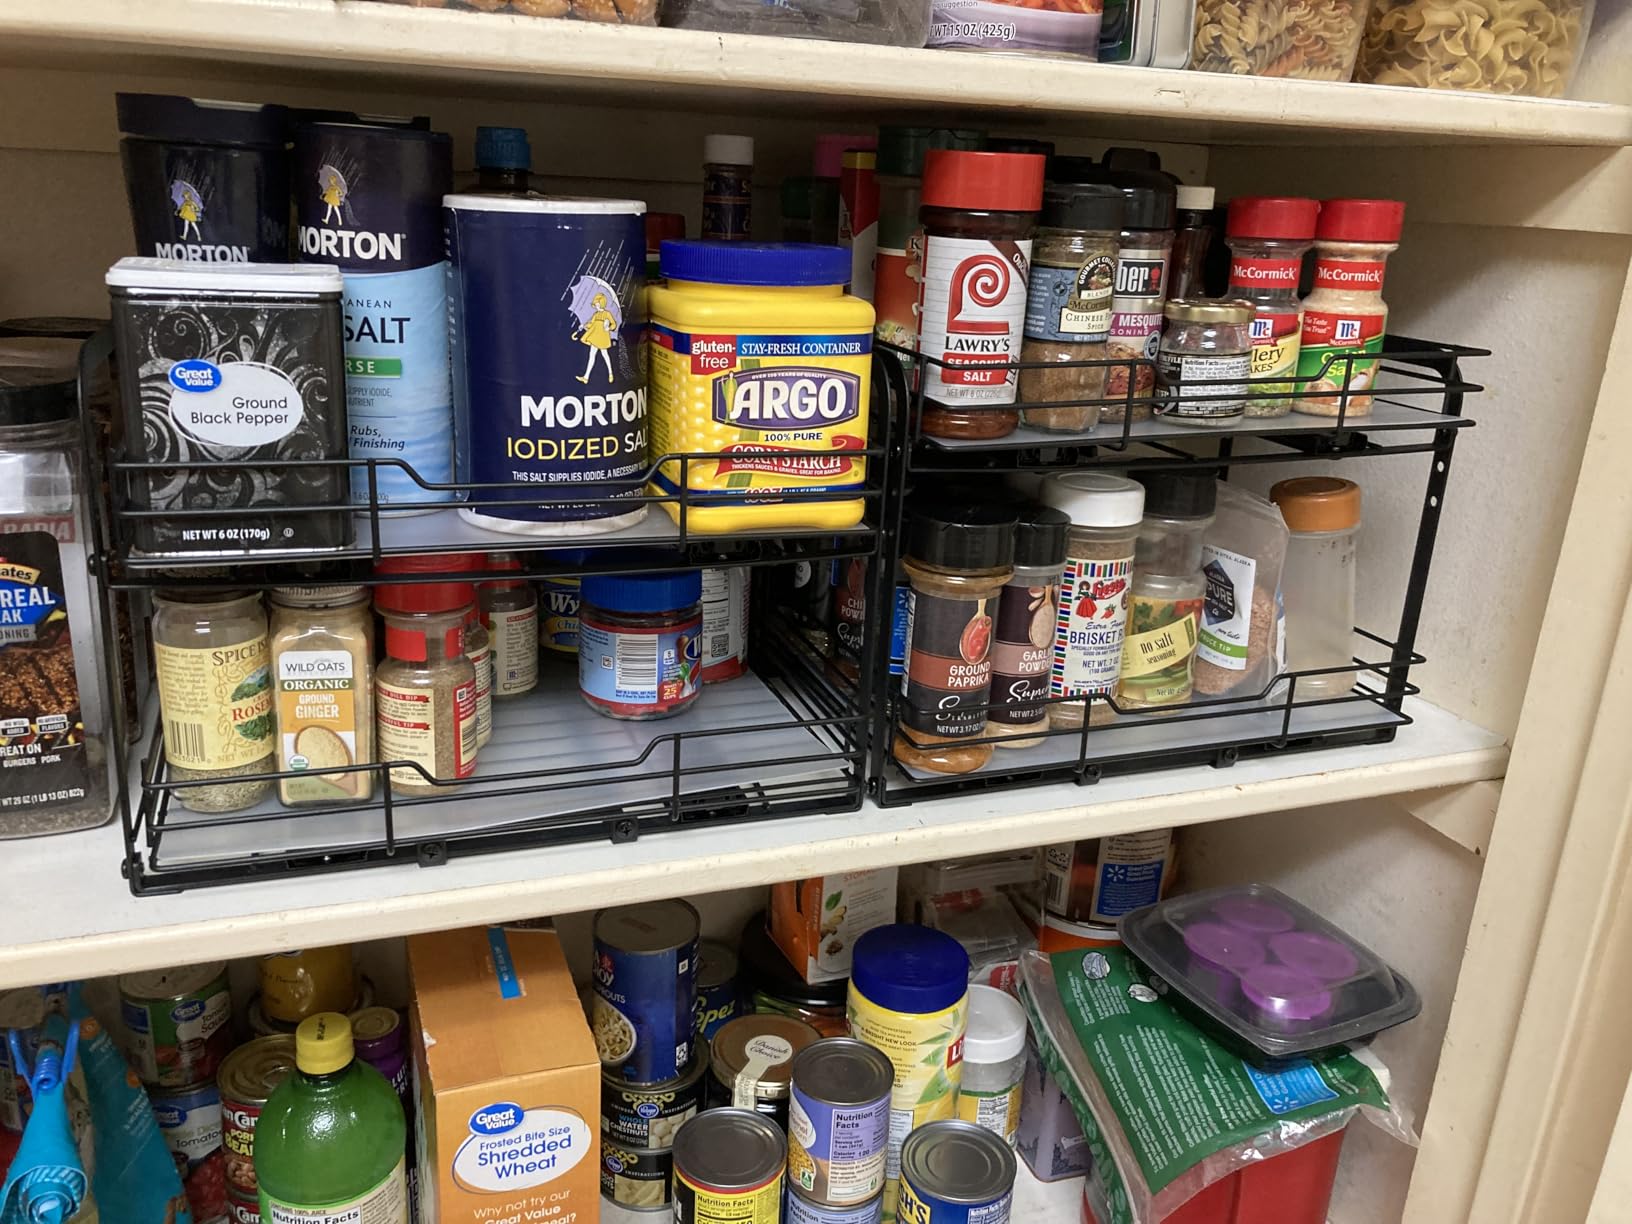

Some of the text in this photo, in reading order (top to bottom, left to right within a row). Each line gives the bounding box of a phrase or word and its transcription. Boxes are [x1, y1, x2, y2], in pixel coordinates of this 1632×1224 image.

[935, 25, 948, 36] WT
[950, 25, 960, 36] 15
[963, 24, 976, 36] OZ
[978, 24, 1016, 40] (425g)
[155, 242, 249, 263] MORTON
[1078, 257, 1101, 285] GOURMET
[1234, 265, 1296, 280] McCormick
[1318, 267, 1381, 283] McCormick
[1065, 312, 1104, 322] CHINESE
[344, 316, 411, 344] SALT
[692, 340, 736, 355] gluten-
[742, 342, 862, 355] STAY-FRESH CONTAINER
[944, 336, 1010, 352] LAWRY'S
[700, 356, 728, 368] free
[1252, 348, 1284, 364] lery
[176, 366, 212, 380] Great
[963, 372, 992, 382] SALT
[184, 376, 214, 386] Value
[730, 379, 847, 420] ARGO
[946, 388, 958, 398] NET
[959, 388, 969, 398] WT
[232, 396, 288, 410] Ground
[520, 386, 647, 428] MORTON
[191, 411, 289, 426] Black Pepper
[351, 425, 382, 437] Rubs,
[764, 432, 823, 442] 100% PURE
[354, 437, 405, 451] Finishing
[507, 436, 619, 460] IODIZED
[782, 448, 841, 470] STARCH
[512, 471, 528, 482] THIS
[530, 472, 547, 482] SALT
[548, 471, 582, 482] SUPPLIES
[583, 470, 606, 481] IODIDE,
[607, 469, 613, 478] A
[182, 528, 270, 541] NET WT 6 OZ (170g)
[1234, 558, 1251, 566] ALASKA
[1208, 582, 1233, 606] PURE
[1086, 622, 1107, 630] Extra
[1070, 630, 1117, 646] BRISKET
[1140, 632, 1175, 655] no salt
[212, 644, 257, 666] SPICE
[1220, 644, 1231, 652] TIP
[1146, 648, 1176, 665] seasoning
[286, 662, 345, 672] WILD OATS
[949, 661, 990, 676] GROUND
[1082, 660, 1095, 668] NET
[1098, 660, 1108, 668] WT.
[284, 679, 350, 690] ORGANIC
[947, 674, 990, 688] PAPRIKA
[298, 694, 335, 704] GROUND
[664, 688, 677, 696] 25
[296, 705, 340, 718] GINGER
[1010, 710, 1030, 718] NET WT
[936, 724, 948, 733] NET
[948, 724, 958, 733] WT
[26, 744, 42, 754] ON
[3, 754, 62, 768] BURGERS PORK
[22, 796, 30, 804] OZ
[39, 794, 48, 802] LB
[48, 792, 56, 800] 13
[57, 790, 68, 800] OZ)
[866, 1029, 885, 1040] BRIGHT
[885, 1037, 899, 1045] NEW
[476, 1108, 515, 1122] Great
[619, 1114, 648, 1124] WHOLE
[836, 1111, 873, 1122] Nutrition
[486, 1118, 515, 1130] Value
[610, 1122, 648, 1136] CHESTNUTS
[618, 1120, 648, 1130] WATER
[480, 1126, 570, 1151] Frosted Bite Size
[478, 1134, 572, 1166] Shredded
[494, 1154, 557, 1180] Wheat
[473, 1190, 570, 1220] Why not try our
[698, 1194, 754, 1208] Nutrition Facts
[272, 1208, 359, 1224] Nutrition Facts
[484, 1205, 561, 1224] Great Value
[790, 1200, 818, 1222] Nutrition
[790, 1206, 806, 1224] Facts
